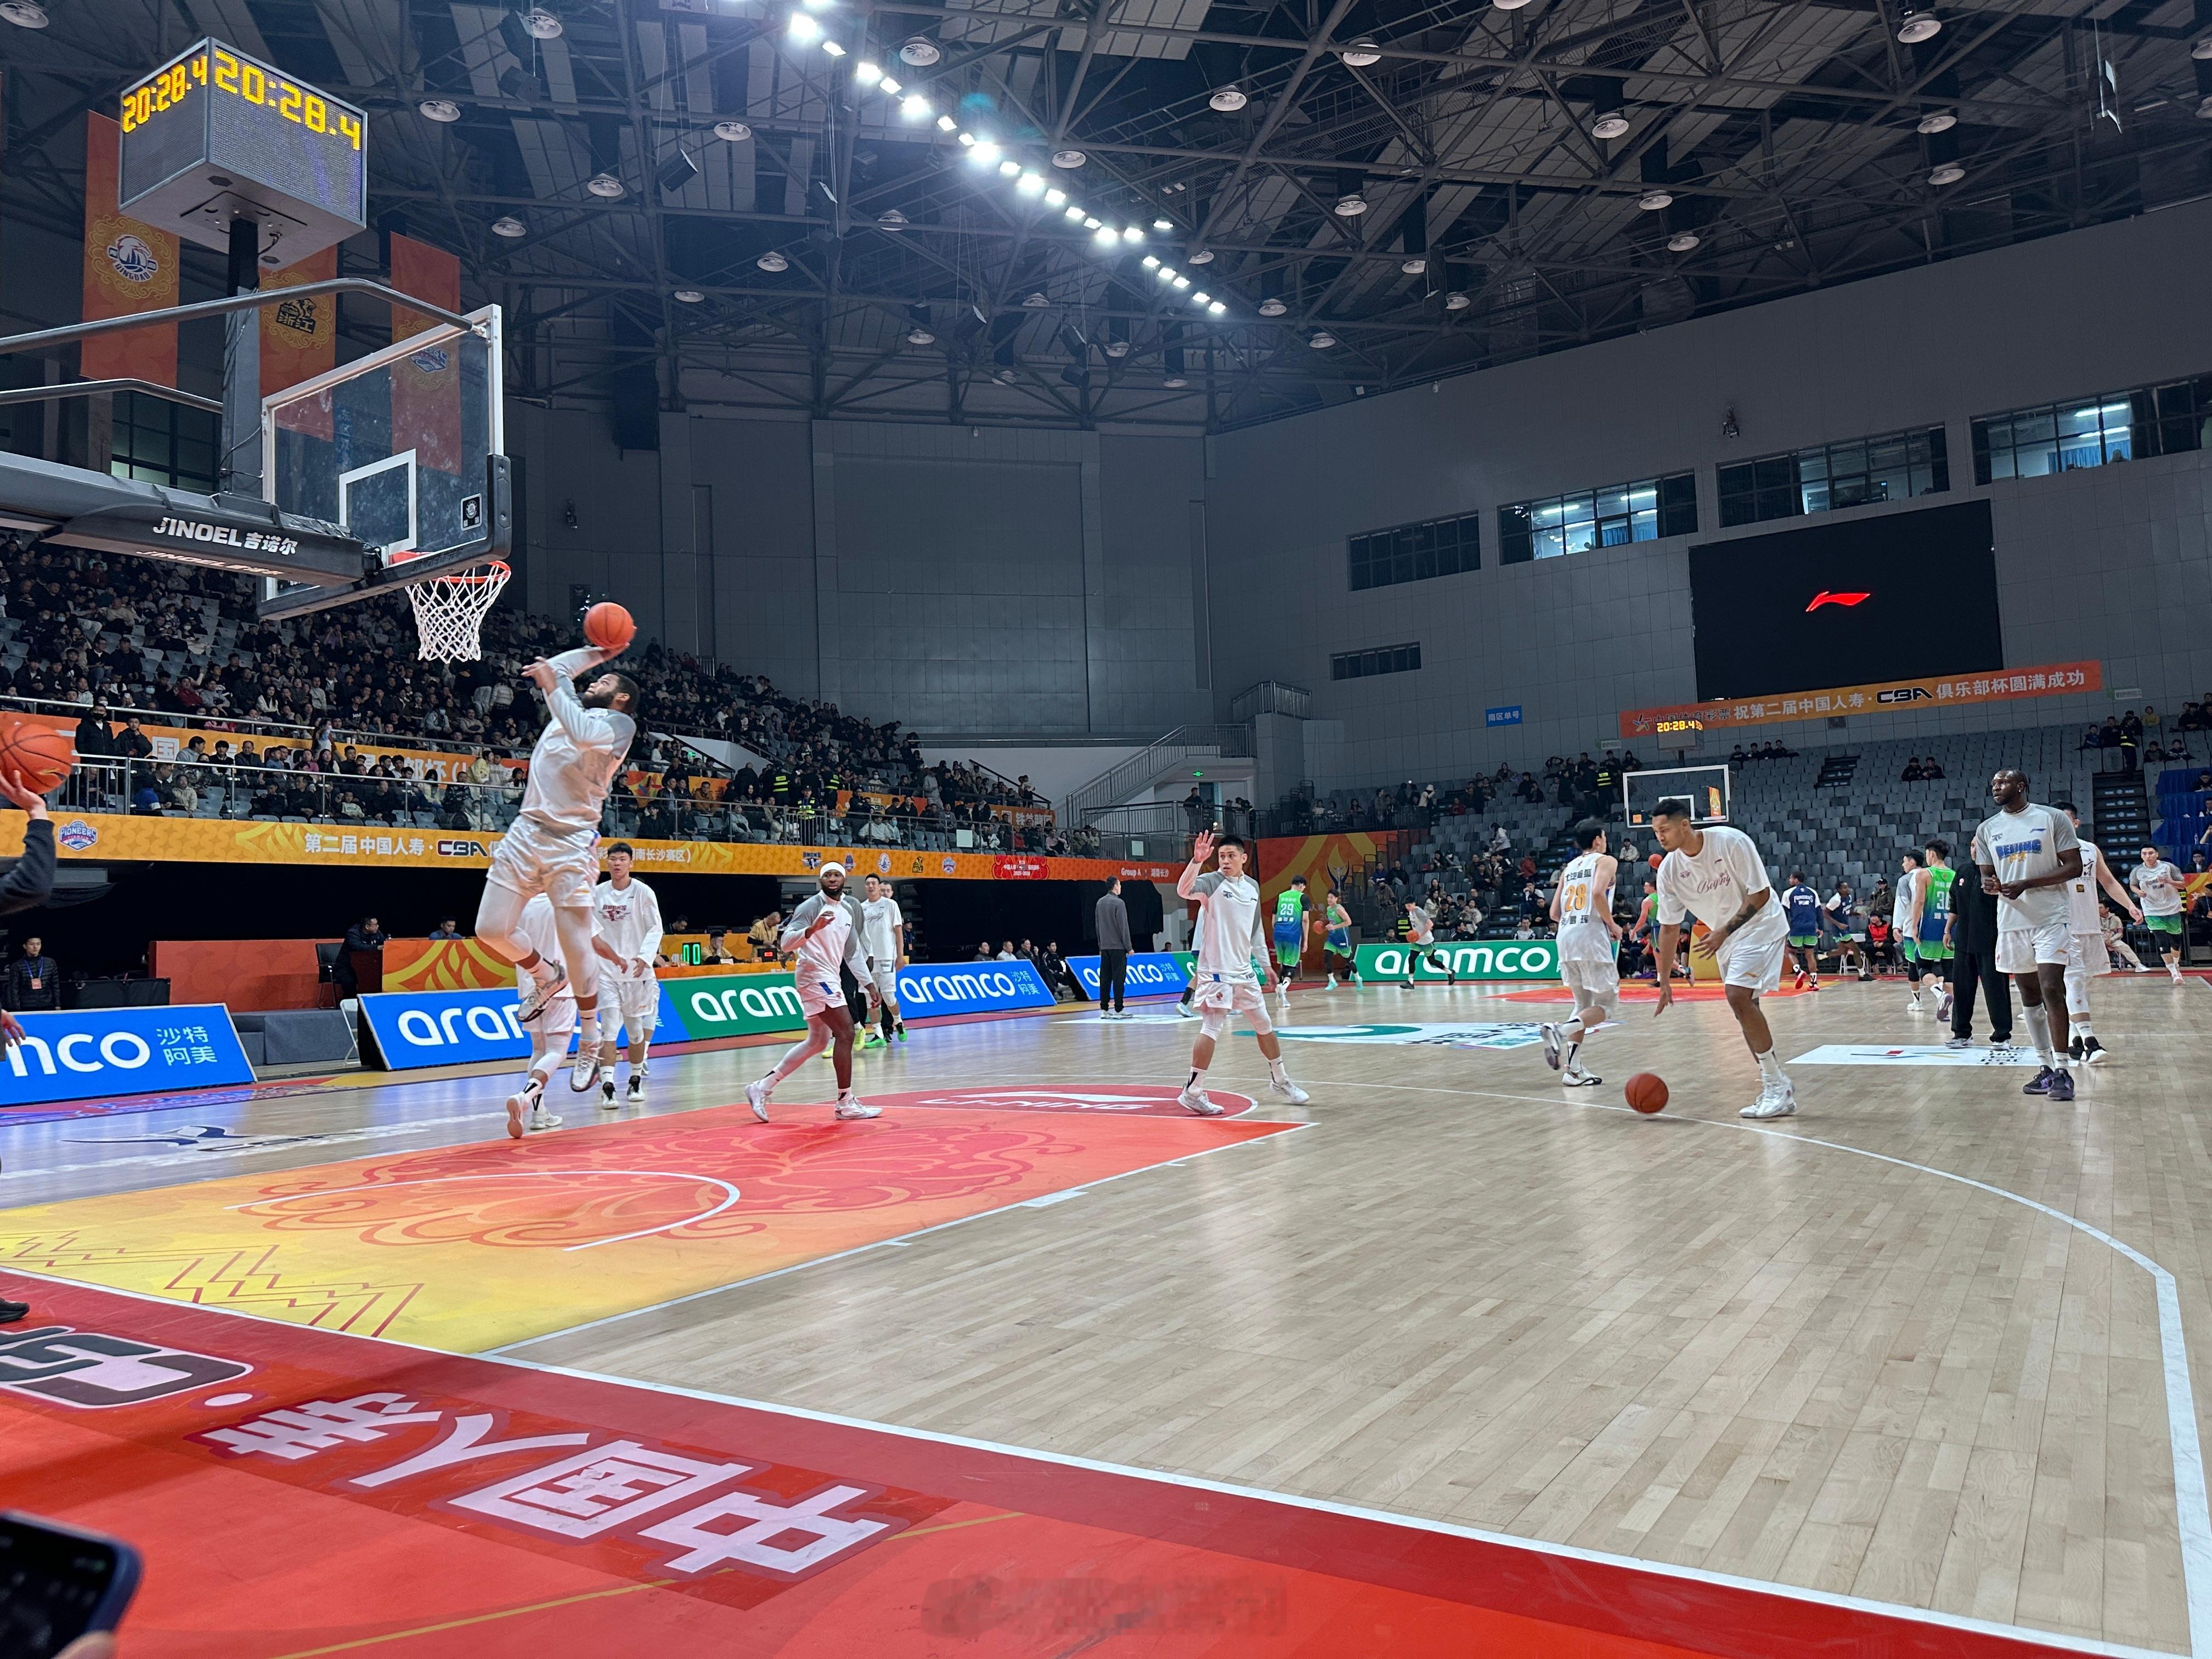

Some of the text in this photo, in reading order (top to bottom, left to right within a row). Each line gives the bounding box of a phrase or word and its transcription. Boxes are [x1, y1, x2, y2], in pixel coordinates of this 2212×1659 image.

[122, 55, 207, 133] 20:28.4
[215, 50, 360, 150] 20:28.4
[115, 263, 151, 281] QINGDAO
[153, 517, 298, 555] JINOEL 吉诺尔
[136, 550, 227, 568] JINOEL
[1876, 687, 1933, 703] CBA
[1936, 669, 2085, 699] 俱乐部杯圆满成功
[1488, 710, 1520, 722] 南区单号
[1656, 720, 1695, 733] 20:28.4
[60, 827, 97, 842] PIONEERS
[437, 840, 488, 856] CBA
[1995, 839, 2042, 860] BEIJING
[1121, 867, 1137, 878] Group
[1565, 884, 1587, 912] 28
[1280, 903, 1294, 916] 29
[1010, 970, 1032, 982] 沙特
[899, 972, 1016, 1003] aramco
[1018, 983, 1041, 996] 阿美
[691, 986, 803, 1022] aram
[156, 1026, 209, 1046] 沙特
[163, 1045, 218, 1066] 阿美
[917, 1098, 1154, 1110] LI-NING
